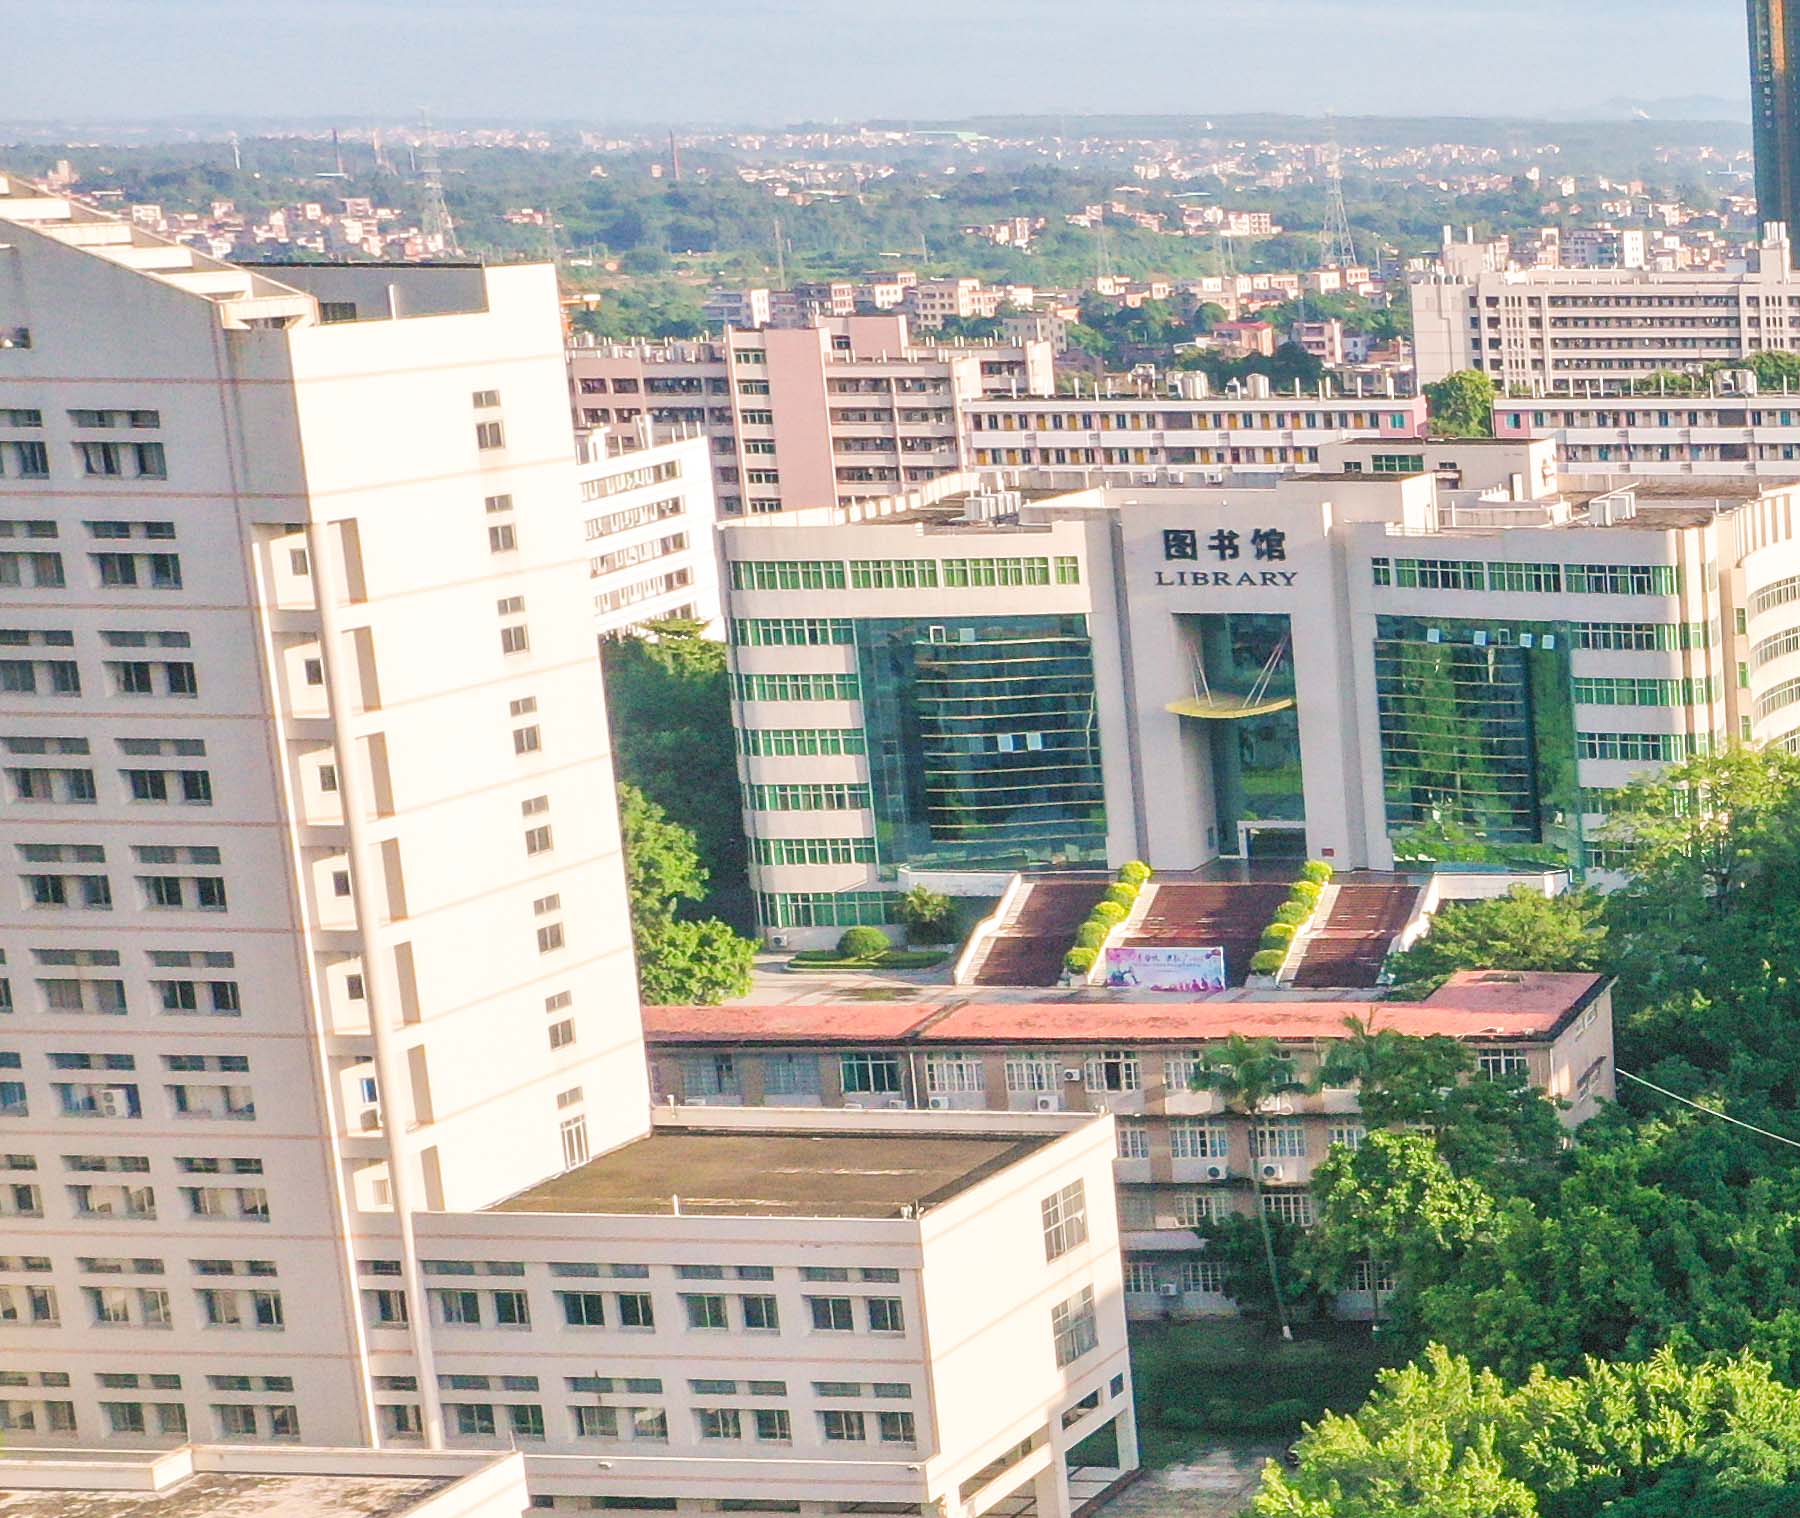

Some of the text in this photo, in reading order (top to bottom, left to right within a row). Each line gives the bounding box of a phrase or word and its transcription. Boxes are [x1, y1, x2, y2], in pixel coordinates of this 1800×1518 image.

[1163, 528, 1287, 561] 图书馆
[1154, 571, 1298, 587] LIBRARY
